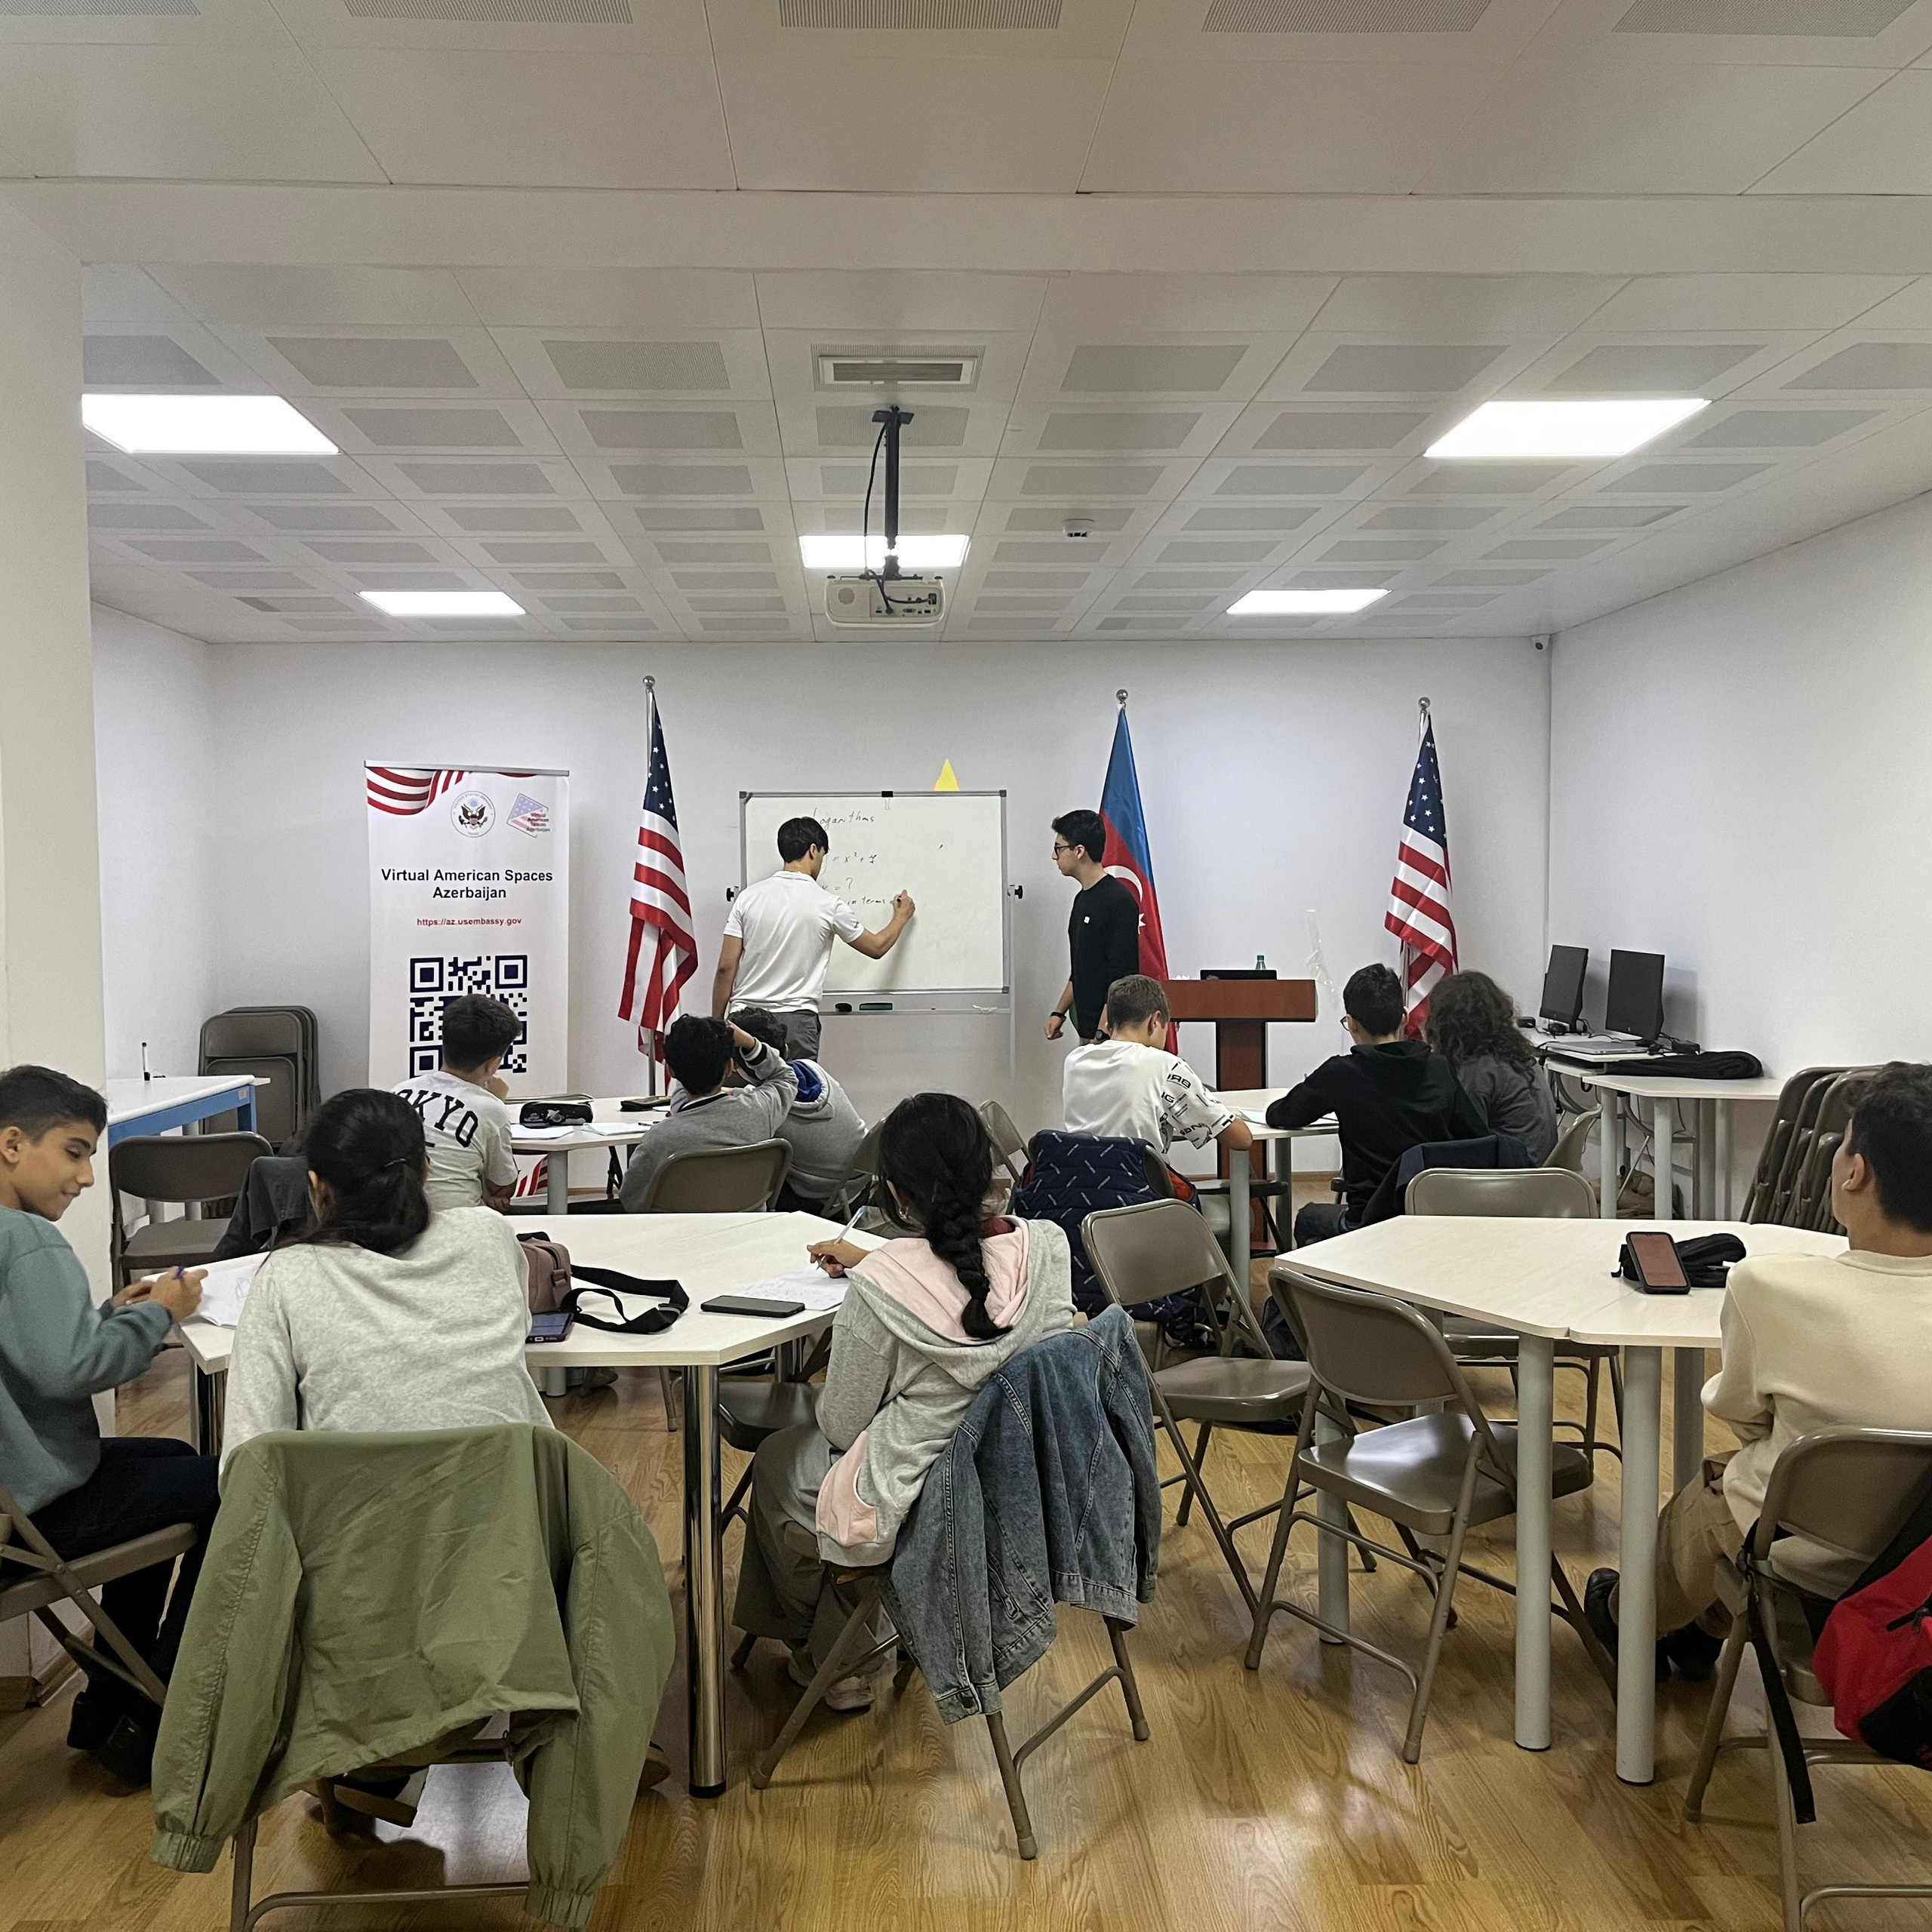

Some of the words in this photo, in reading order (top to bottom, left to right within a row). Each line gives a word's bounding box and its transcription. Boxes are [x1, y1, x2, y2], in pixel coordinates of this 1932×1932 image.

[381, 869, 429, 881] Virtual
[433, 869, 500, 881] American
[504, 869, 553, 884] Spaces
[432, 886, 506, 901] Azerbaijan
[417, 918, 522, 928] https://az.usembassy.gov
